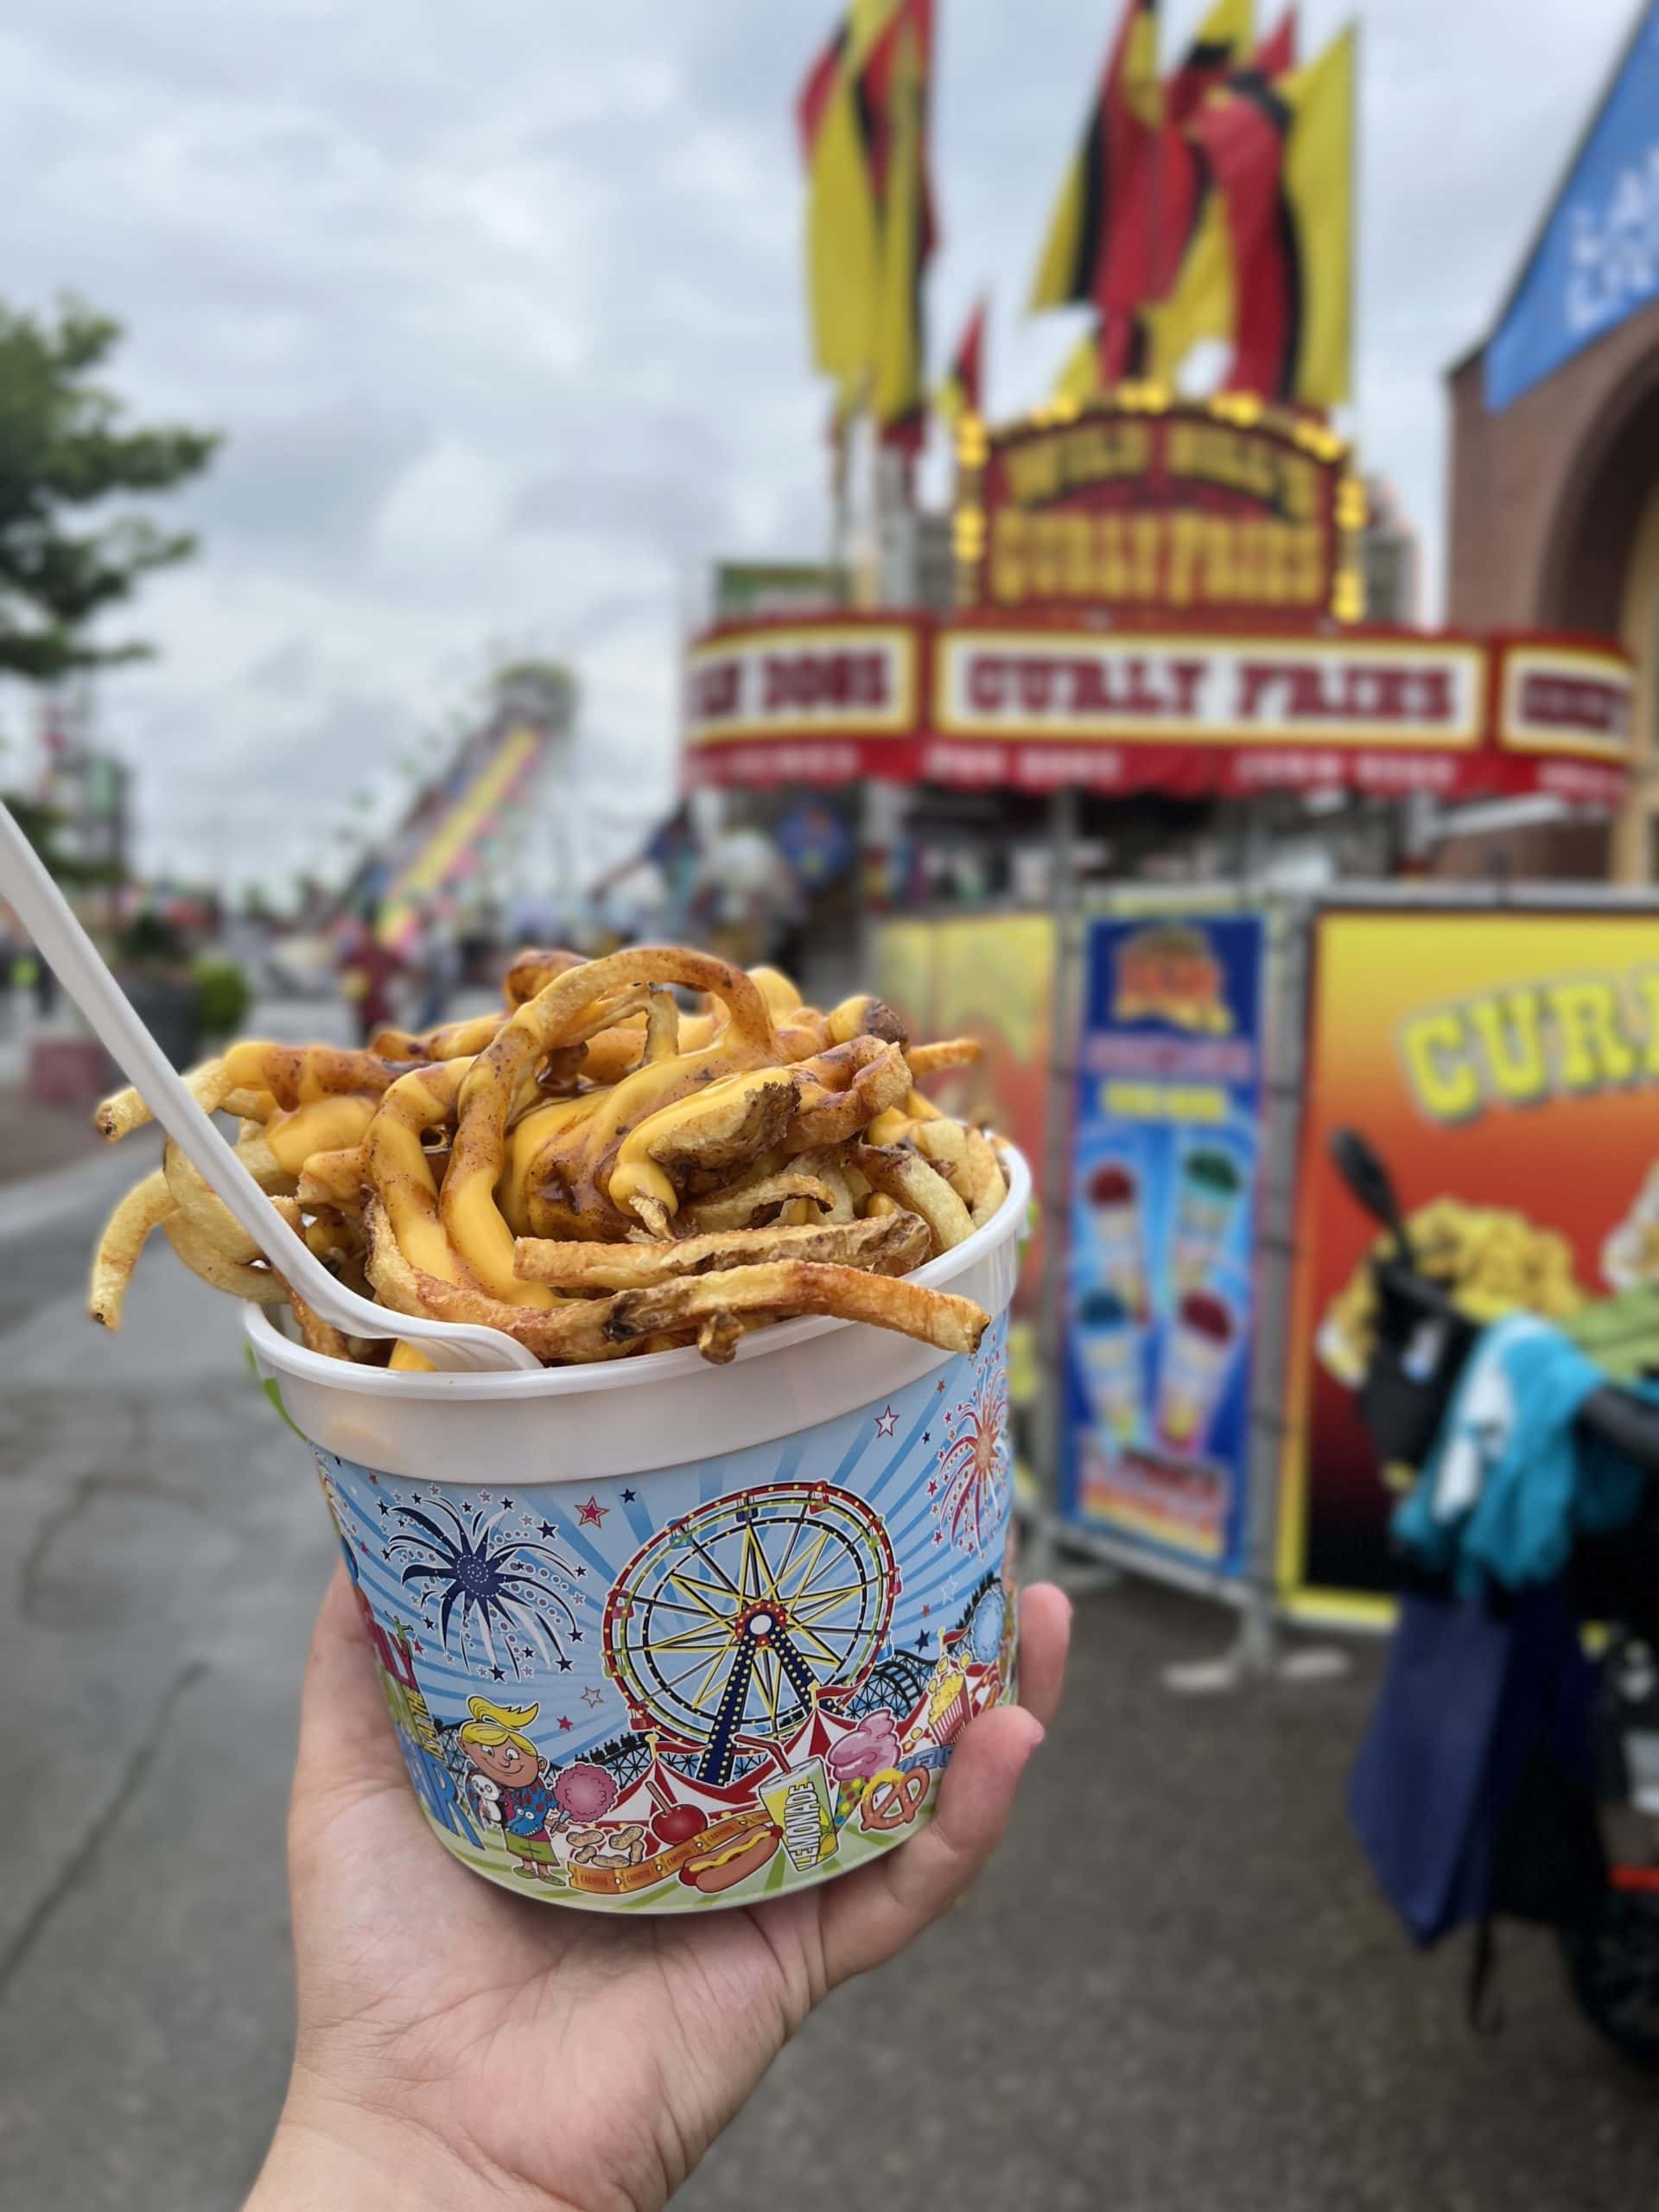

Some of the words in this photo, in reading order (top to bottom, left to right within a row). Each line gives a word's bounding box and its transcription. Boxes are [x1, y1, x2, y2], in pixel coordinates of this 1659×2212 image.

[969, 655, 1209, 716] CURLY
[1237, 661, 1454, 723] FRIES
[784, 1780, 823, 1870] LEMONADE
